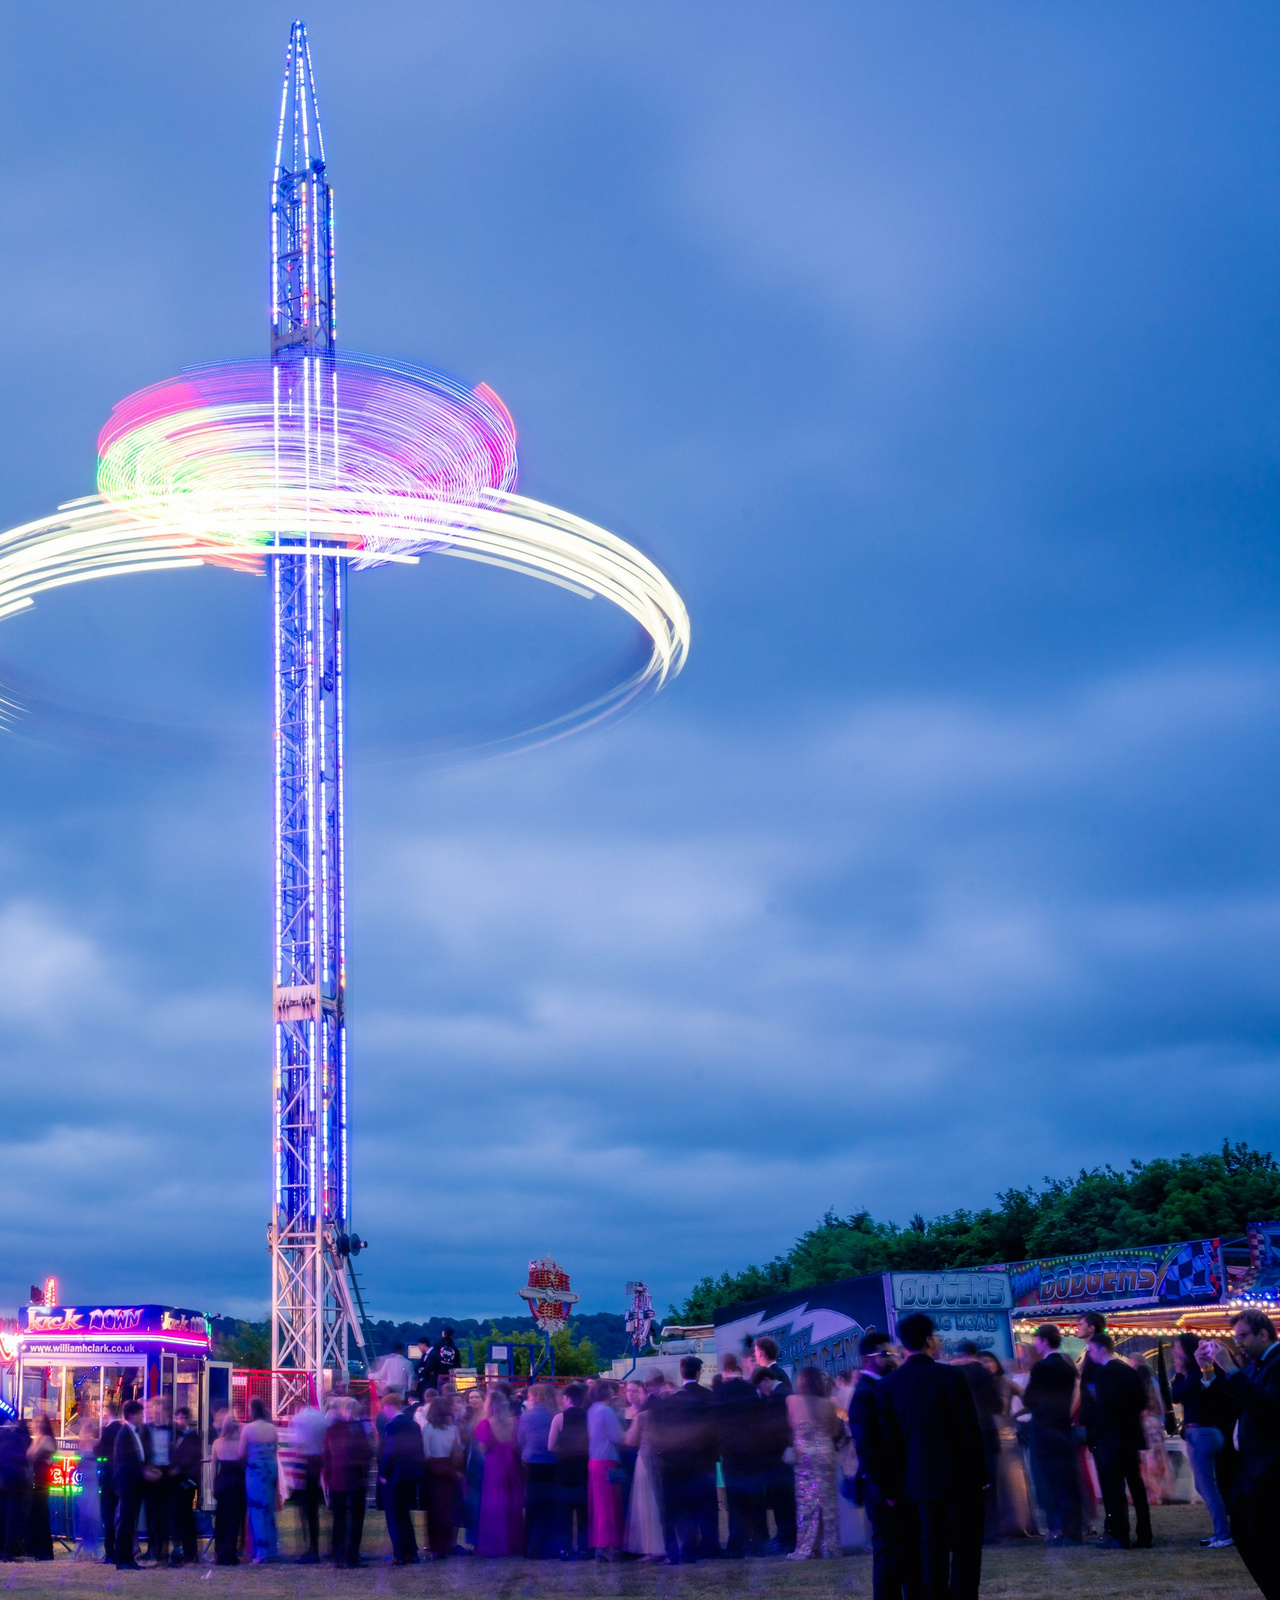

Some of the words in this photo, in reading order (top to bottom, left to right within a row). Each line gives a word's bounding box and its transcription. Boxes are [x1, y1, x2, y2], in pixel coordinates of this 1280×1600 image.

[901, 1274, 1005, 1308] DODGEMS
[1040, 1261, 1159, 1302] DODGEMS
[89, 1308, 144, 1331] DOWN
[955, 1314, 999, 1332] LOAD
[30, 1344, 135, 1354] www.williamhclark.co.uk
